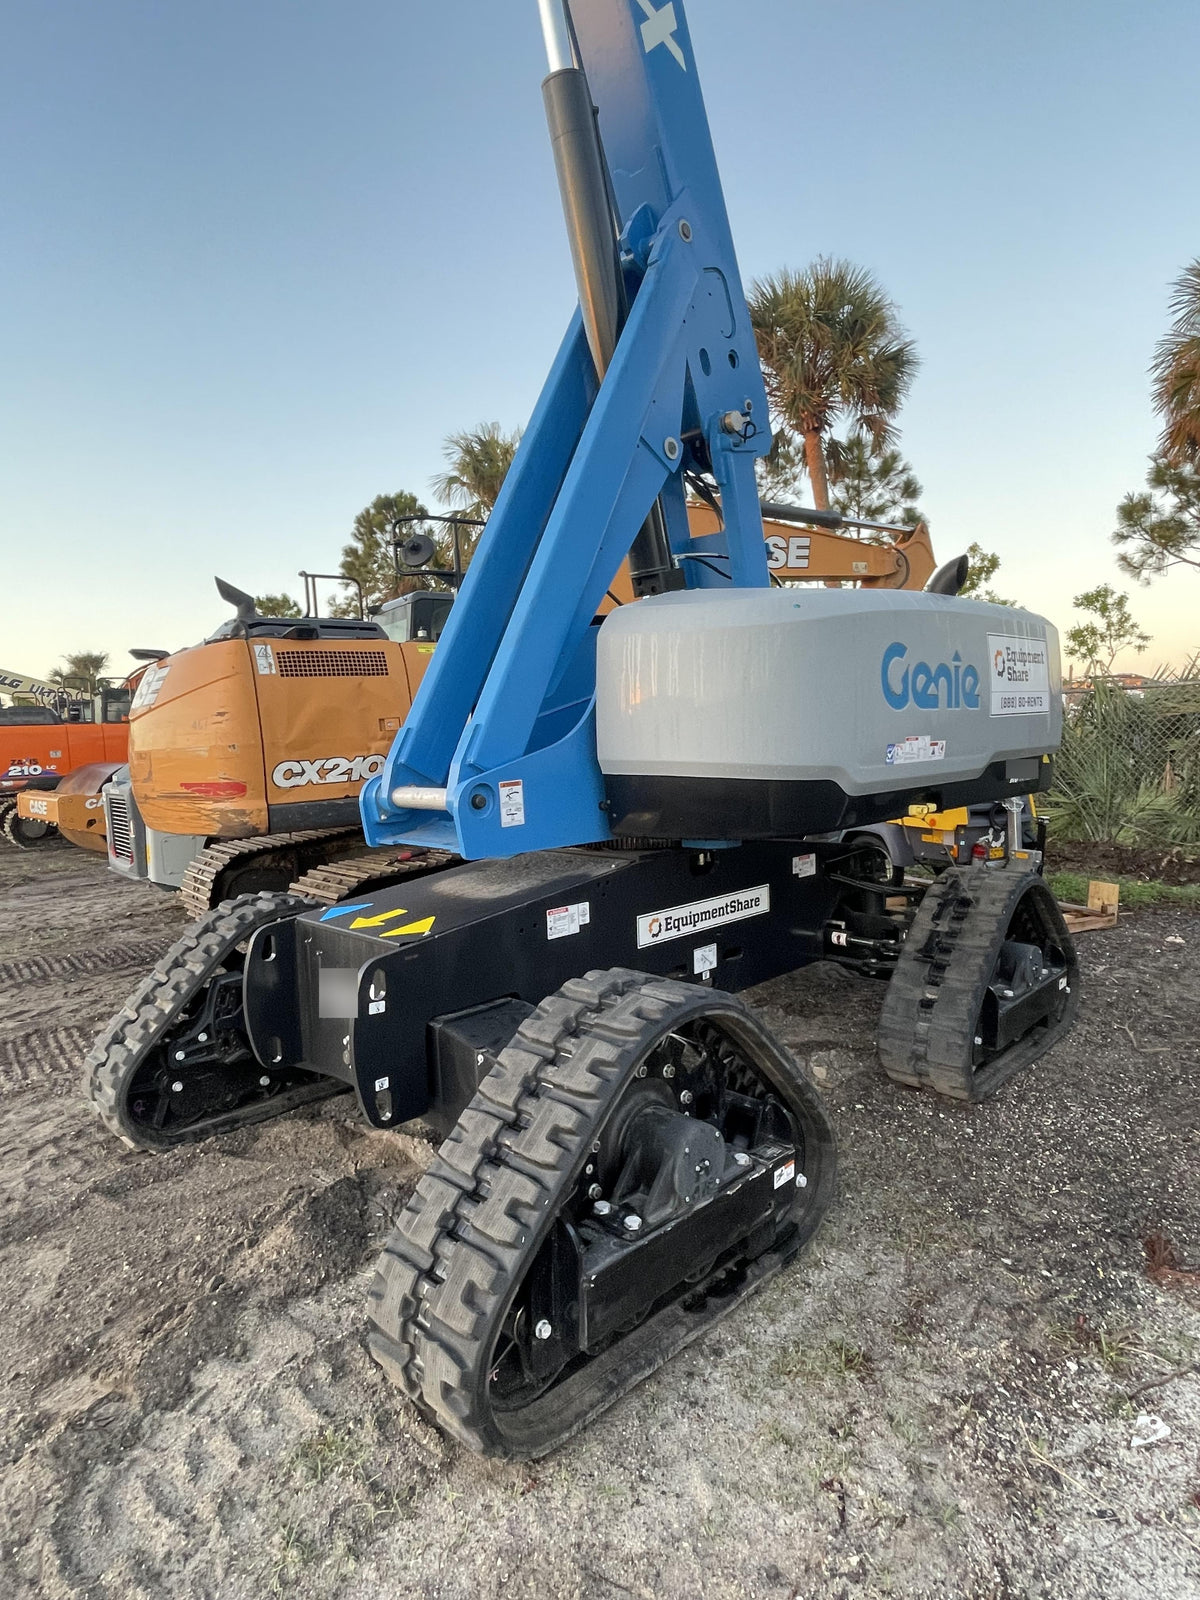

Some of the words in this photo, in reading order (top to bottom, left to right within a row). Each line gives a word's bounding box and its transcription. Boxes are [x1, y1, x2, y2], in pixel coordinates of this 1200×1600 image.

[1006, 647, 1044, 666] Equipment
[881, 642, 980, 710] Genie
[1007, 666, 1028, 681] Share
[8, 765, 43, 777] 210
[272, 755, 386, 788] CX210
[29, 800, 47, 815] CASE
[664, 896, 761, 932] EquipmentShare
